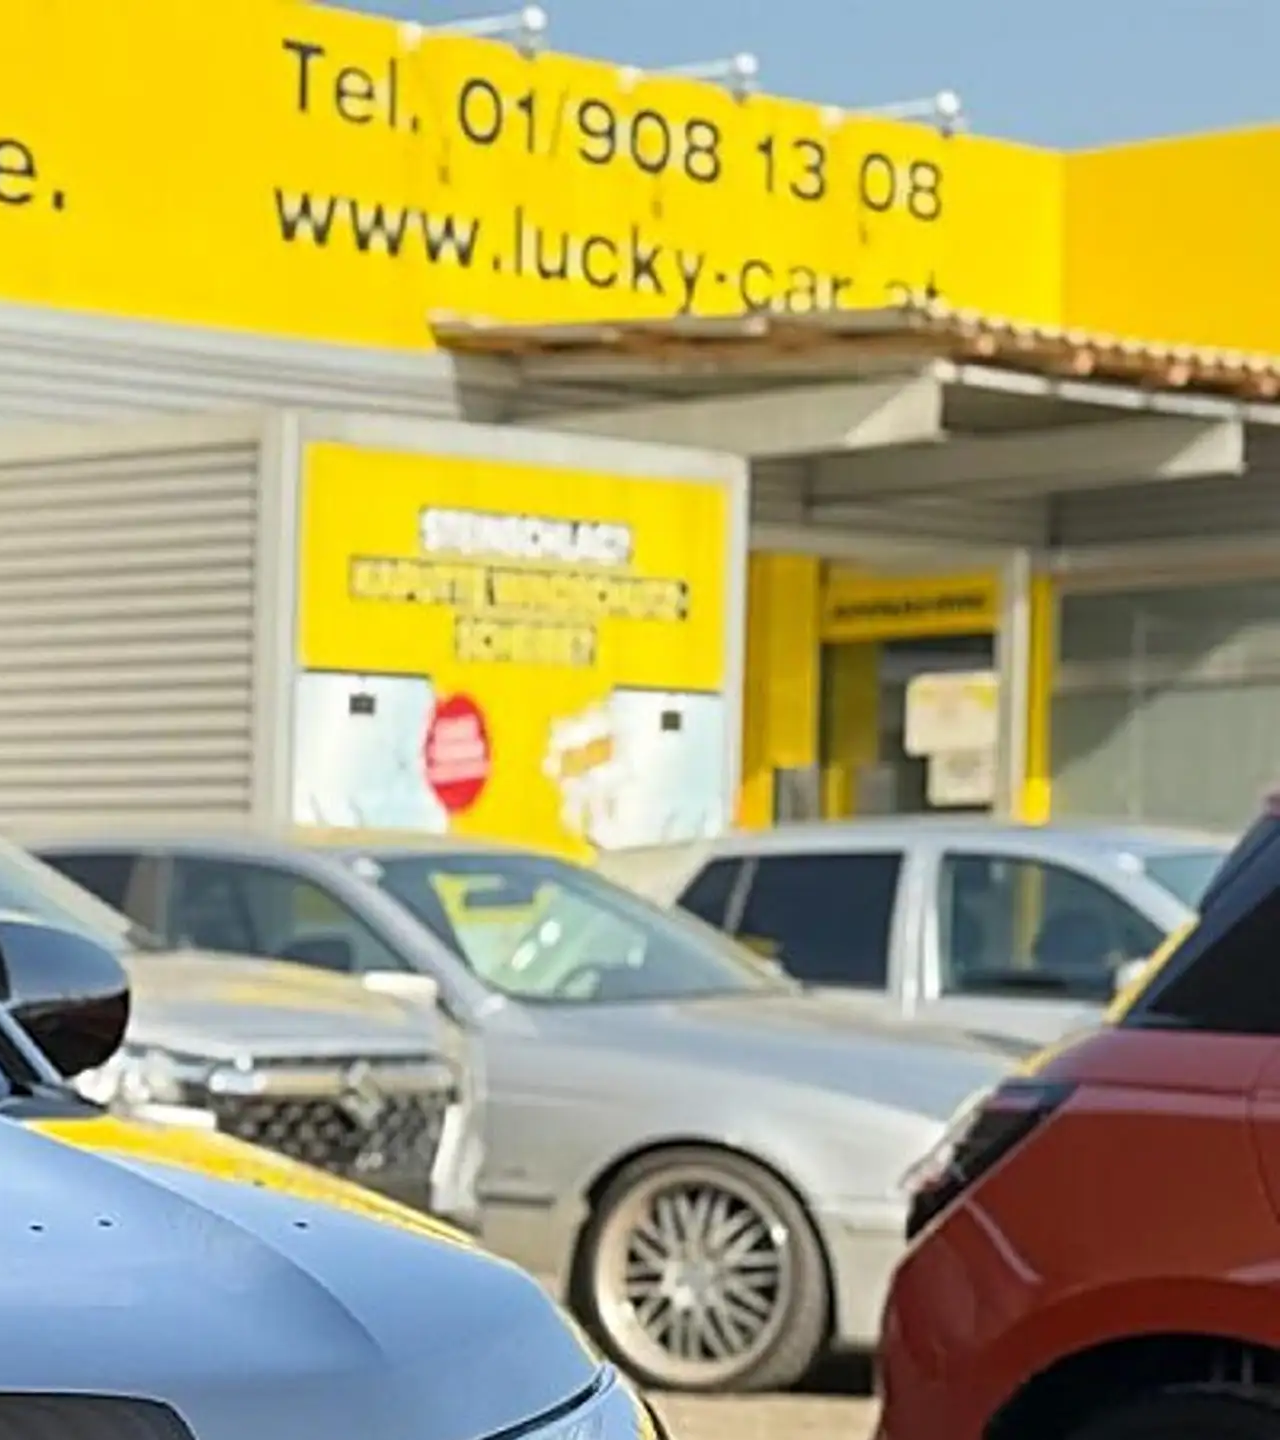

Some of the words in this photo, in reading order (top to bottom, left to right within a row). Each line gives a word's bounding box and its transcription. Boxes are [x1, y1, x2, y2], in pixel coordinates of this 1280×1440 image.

[282, 37, 420, 134] Tel.
[458, 76, 722, 184] 01/908
[757, 134, 827, 201] 13
[859, 152, 943, 222] 08
